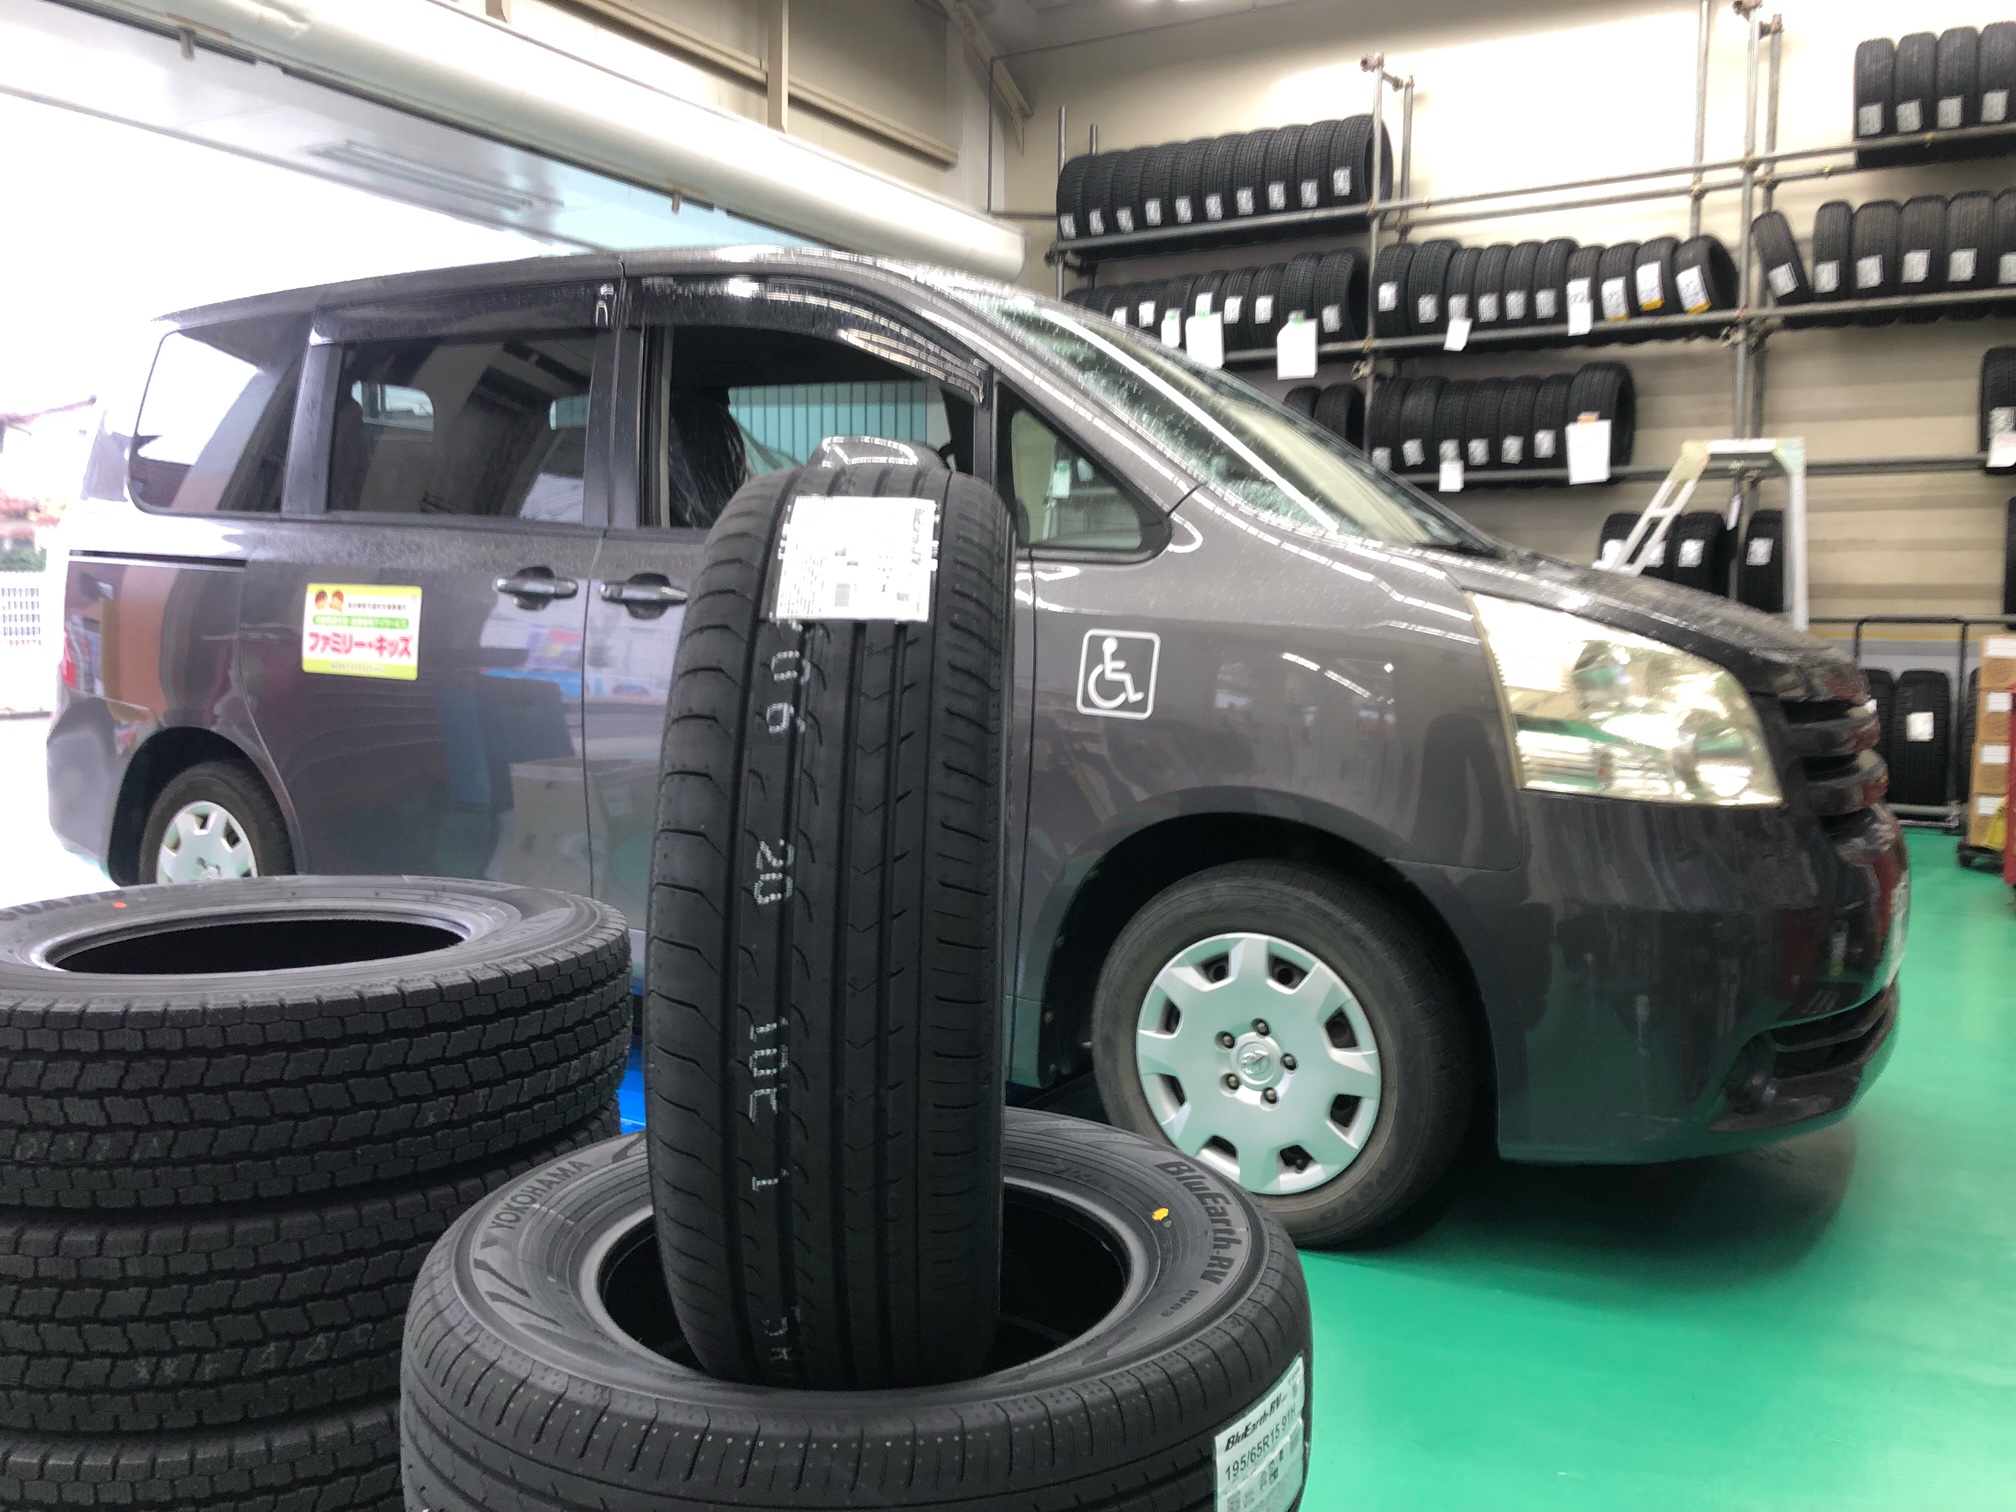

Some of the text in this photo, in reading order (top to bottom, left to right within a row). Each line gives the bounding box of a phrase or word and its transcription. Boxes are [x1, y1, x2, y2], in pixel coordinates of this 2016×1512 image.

[754, 838, 795, 906] 20
[487, 1159, 592, 1231] YOKOHAMA
[1155, 1160, 1243, 1286] BluEarth-RV
[1225, 1423, 1281, 1481] 195/65R15
[1281, 1402, 1297, 1433] 91H
